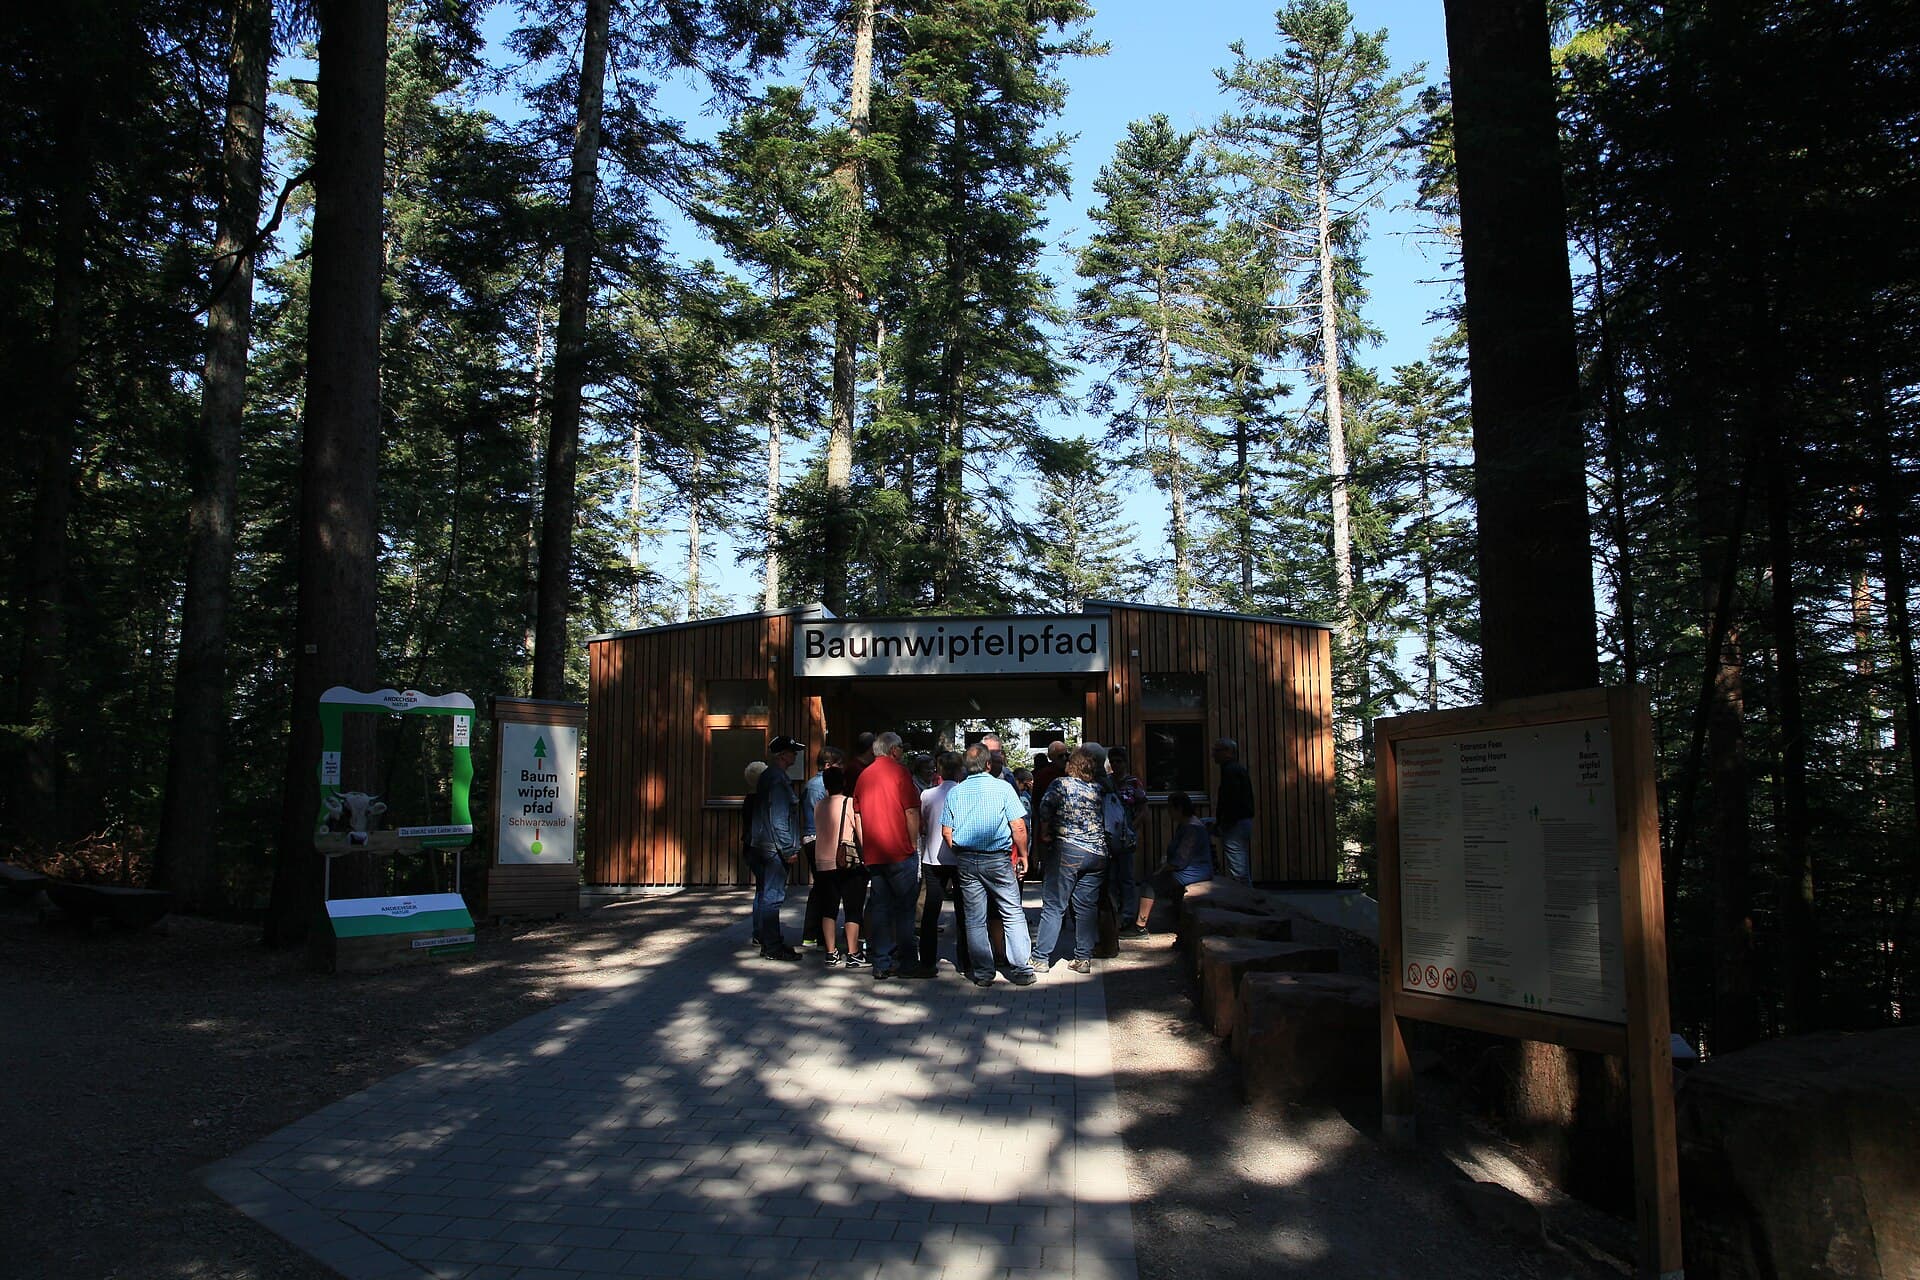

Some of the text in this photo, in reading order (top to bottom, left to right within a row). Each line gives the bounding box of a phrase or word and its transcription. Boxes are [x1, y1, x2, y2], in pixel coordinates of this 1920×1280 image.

[806, 624, 1097, 663] Baumwipfelpfad
[521, 770, 557, 782] Baum
[1461, 765, 1497, 774] Information
[518, 785, 559, 800] wipfel
[523, 801, 553, 816] pfad
[508, 817, 566, 827] Schwarzwald
